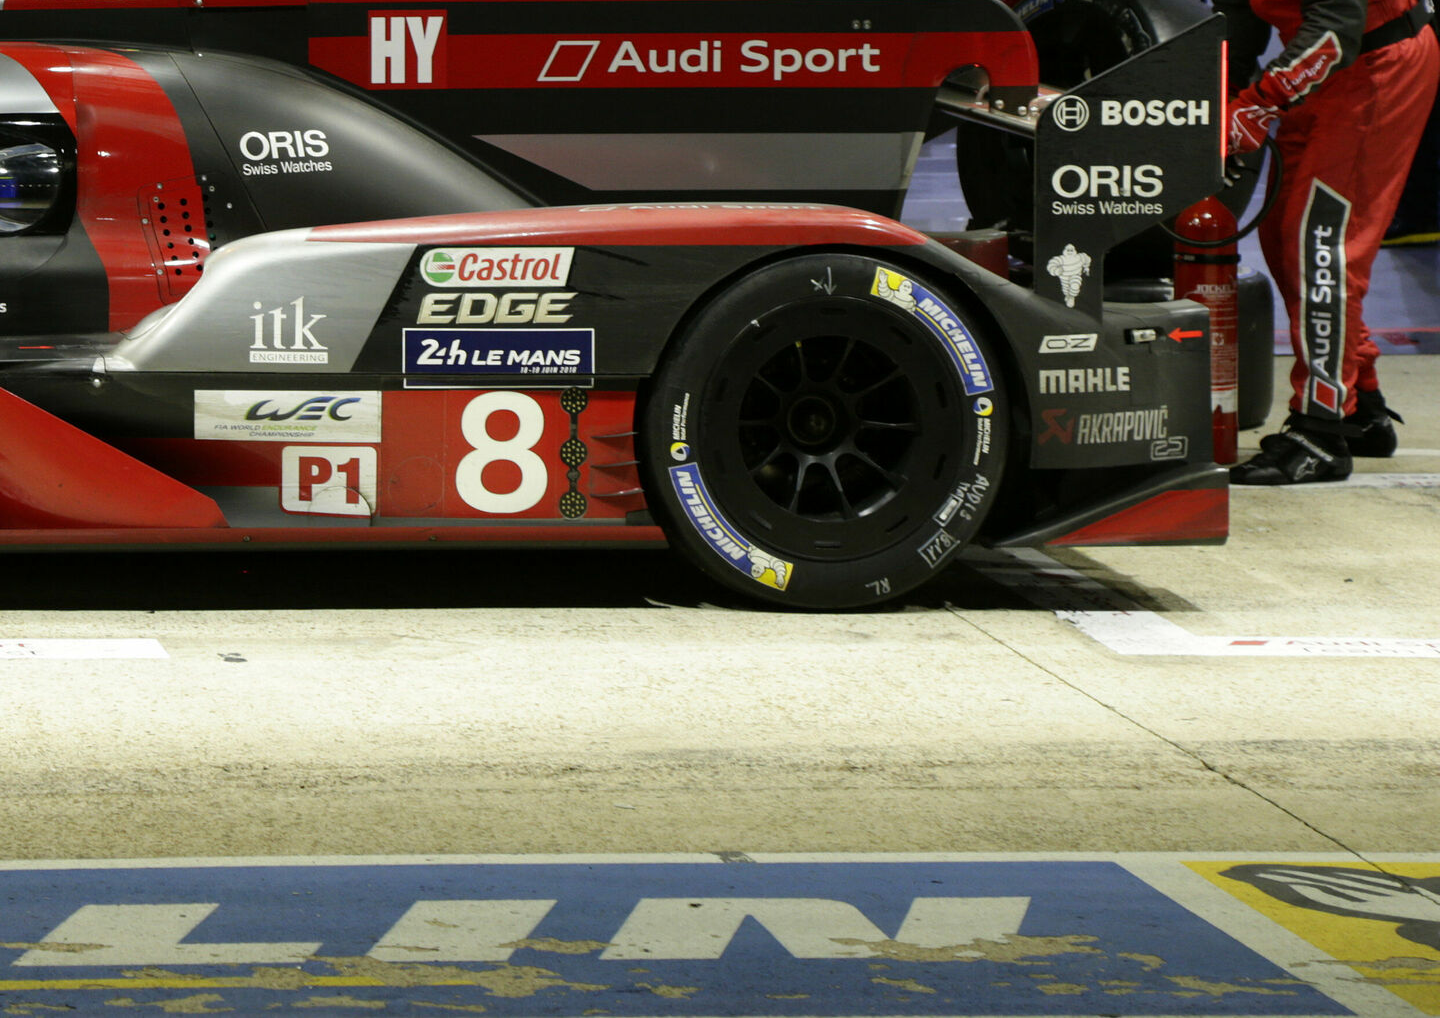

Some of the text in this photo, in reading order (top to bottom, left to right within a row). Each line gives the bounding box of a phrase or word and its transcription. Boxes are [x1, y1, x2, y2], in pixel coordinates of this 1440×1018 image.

[370, 16, 443, 84] HY
[608, 40, 881, 81] Audi Sport
[1101, 99, 1210, 126] BOSCH
[240, 129, 330, 161] ORIS
[243, 160, 333, 176] Swiss Watches
[1051, 164, 1164, 198] ORIS
[1052, 200, 1164, 215] Swiss Watches
[458, 253, 562, 281] Castrol
[416, 292, 579, 325] EDGE
[1311, 225, 1336, 377] Audi Sport
[249, 296, 328, 350] itk
[252, 353, 326, 363] ENGINEERING
[471, 349, 505, 366] LE
[507, 349, 581, 366] MANS
[918, 297, 989, 390] MICHELIN
[1046, 336, 1093, 350] OZ
[1039, 367, 1131, 394] MAHLE
[244, 396, 362, 422] WEC
[261, 424, 318, 432] ENDURANCE
[455, 390, 549, 514] 8
[298, 456, 361, 504] P1
[675, 469, 749, 561] MICHELIN
